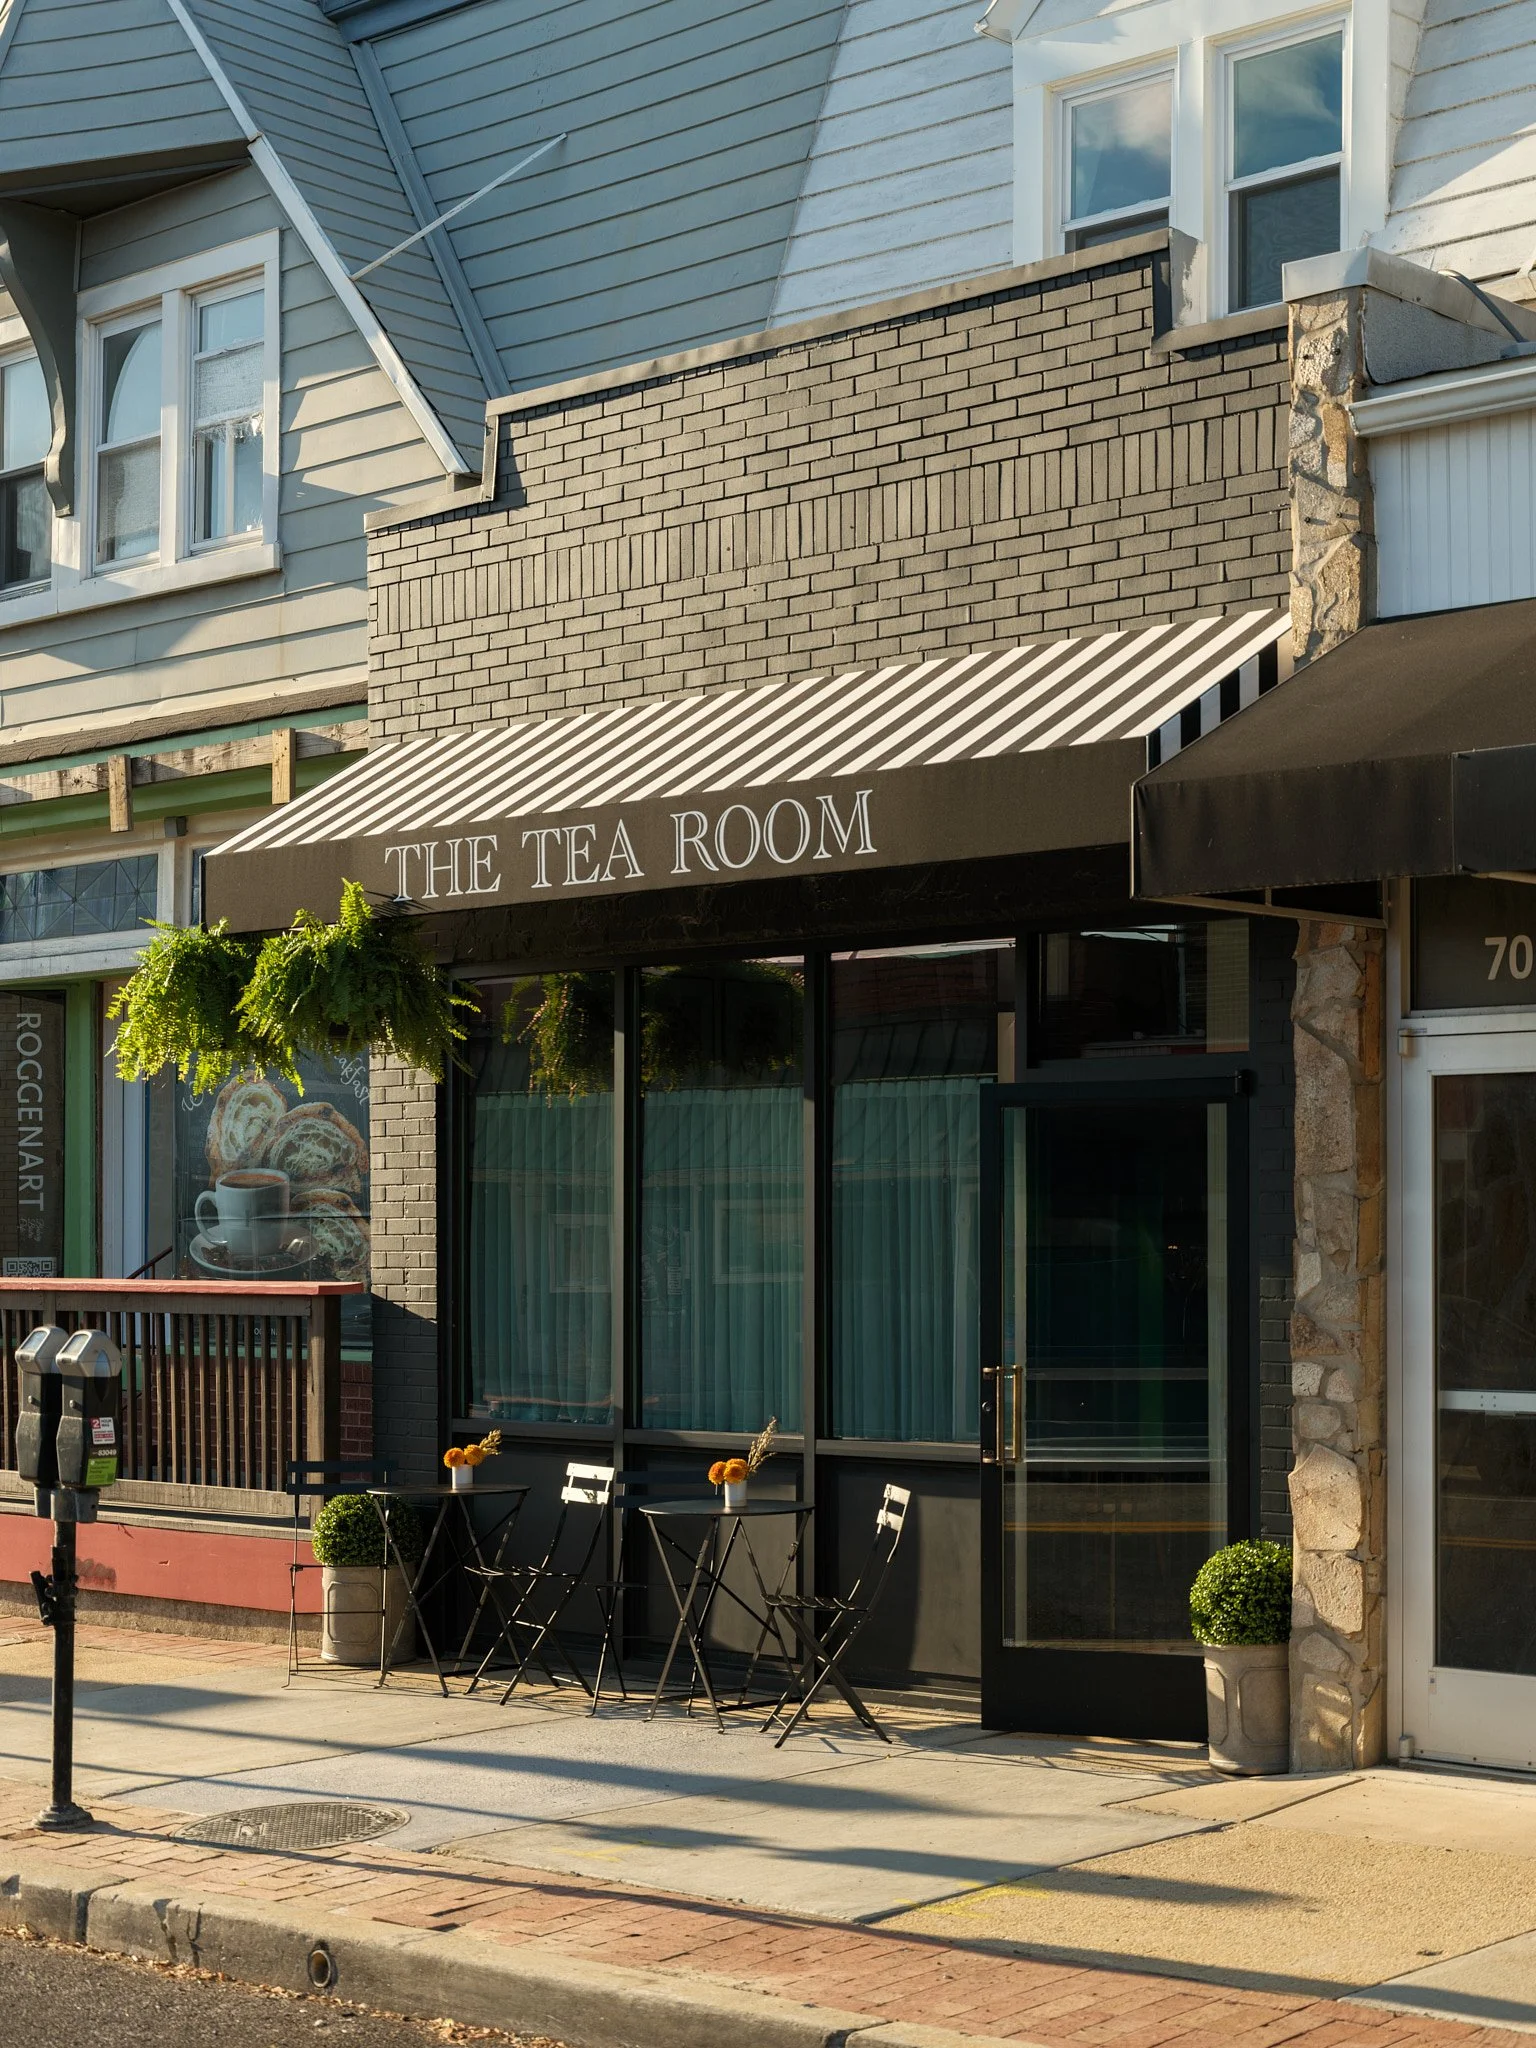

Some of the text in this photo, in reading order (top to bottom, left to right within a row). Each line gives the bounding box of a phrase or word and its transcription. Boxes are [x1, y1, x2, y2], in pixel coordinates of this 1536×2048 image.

[384, 789, 877, 902] THE TEA ROOM
[1484, 934, 1534, 981] 70
[16, 1013, 44, 1212] ROGGENART
[92, 1419, 100, 1428] 2
